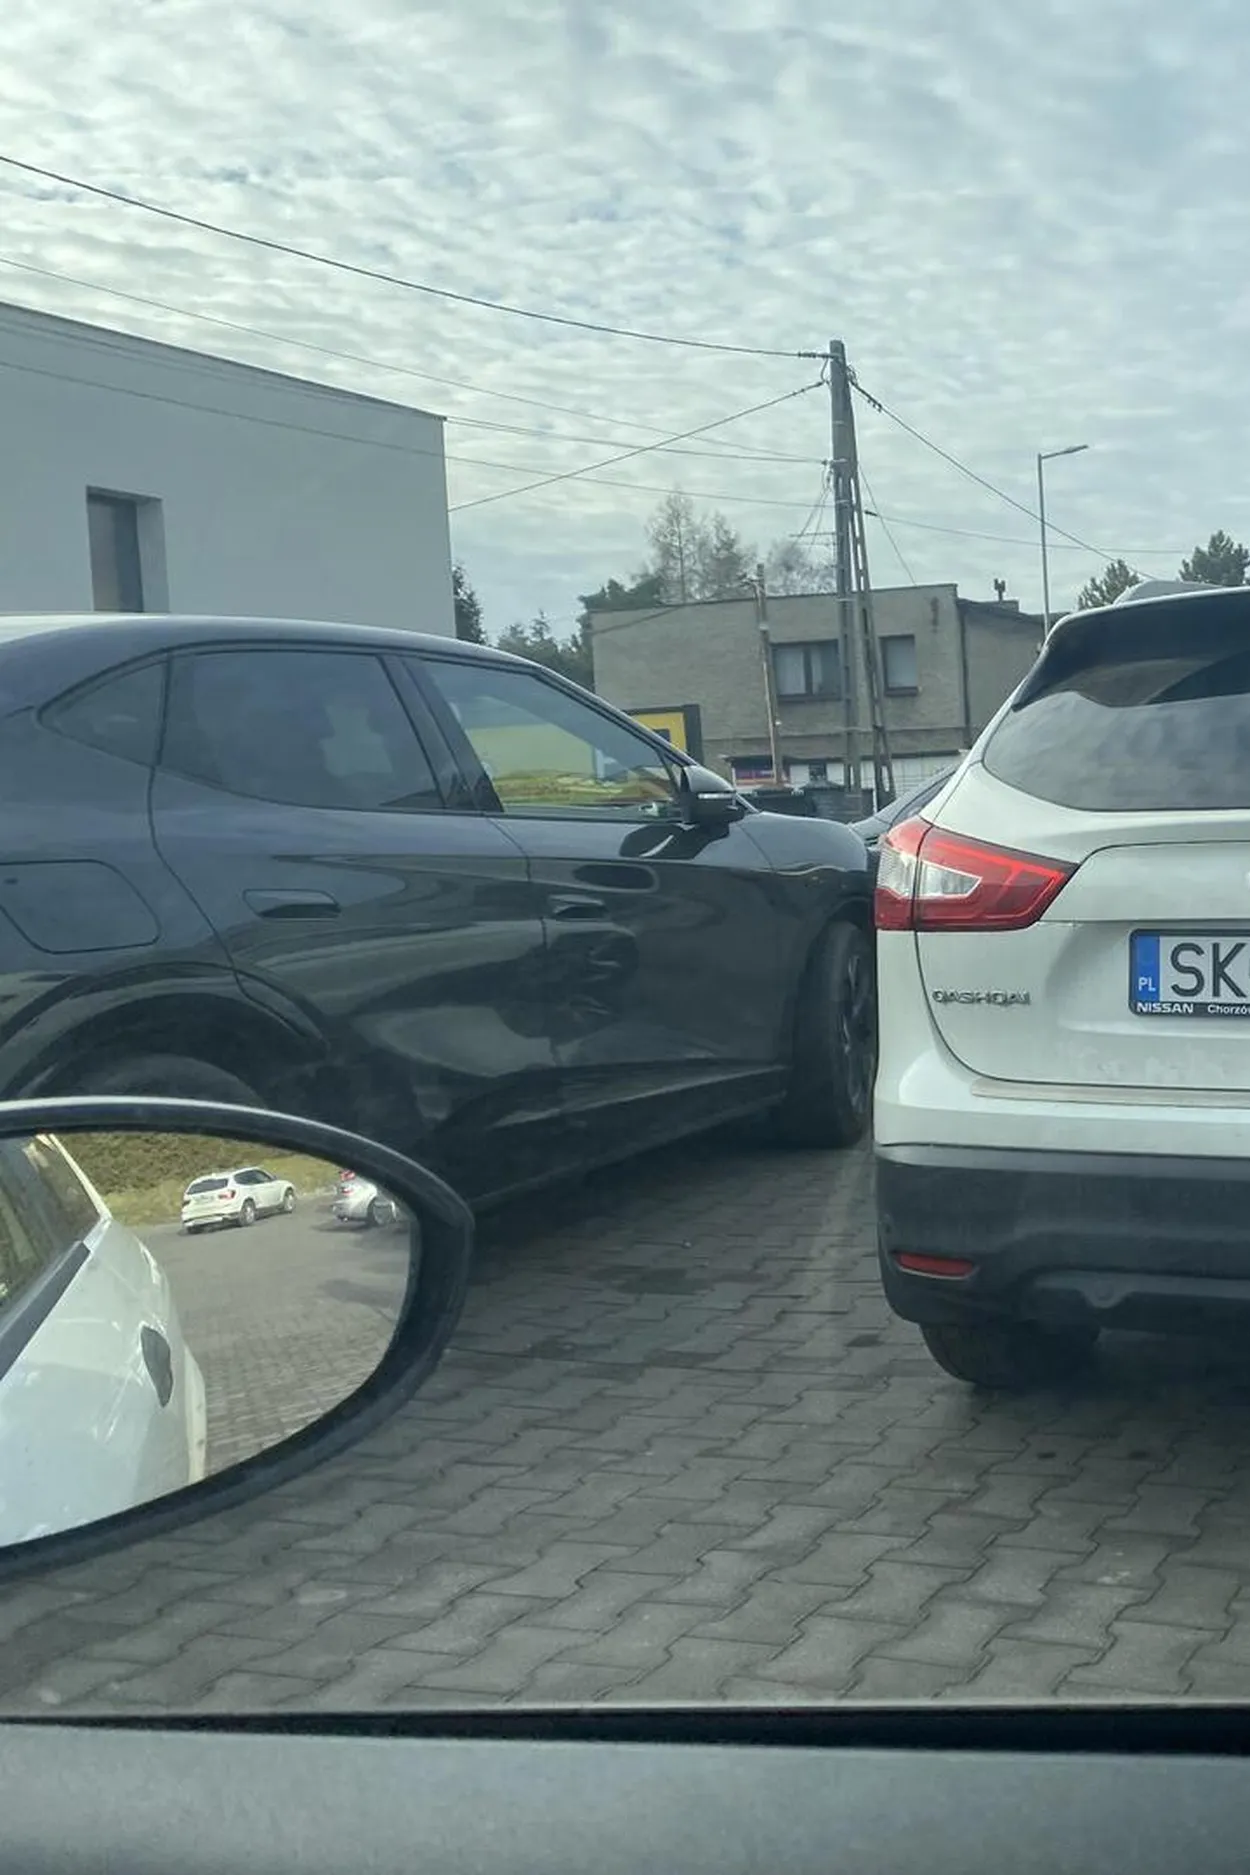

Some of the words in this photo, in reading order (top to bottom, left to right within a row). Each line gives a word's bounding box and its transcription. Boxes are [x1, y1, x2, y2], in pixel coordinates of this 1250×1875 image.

[1170, 942, 1247, 998] SK
[1138, 977, 1156, 992] PL
[1136, 1002, 1194, 1014] NISSAN
